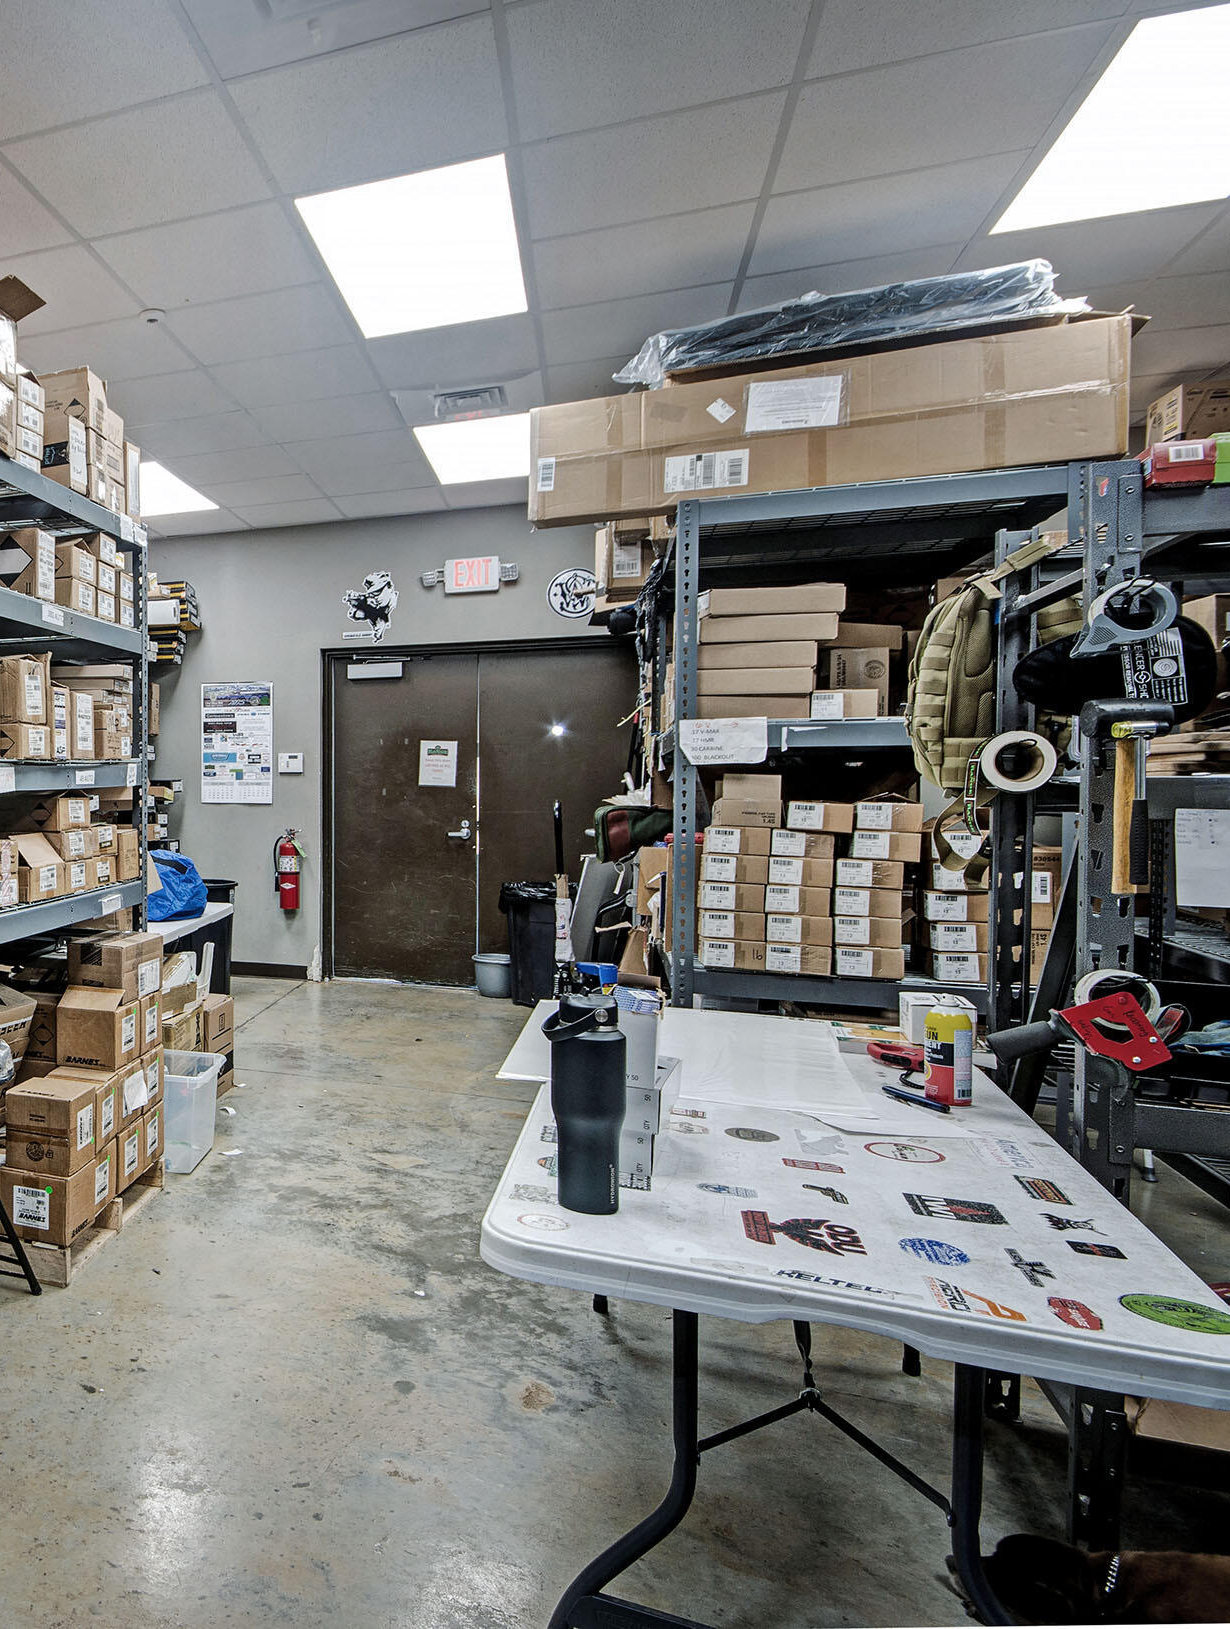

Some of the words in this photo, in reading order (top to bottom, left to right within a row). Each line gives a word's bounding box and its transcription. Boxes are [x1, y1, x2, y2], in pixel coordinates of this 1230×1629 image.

[453, 558, 493, 589] EXIT
[1133, 645, 1146, 671] ENCER
[65, 1056, 100, 1066] BARNES
[19, 1212, 46, 1223] BARNES
